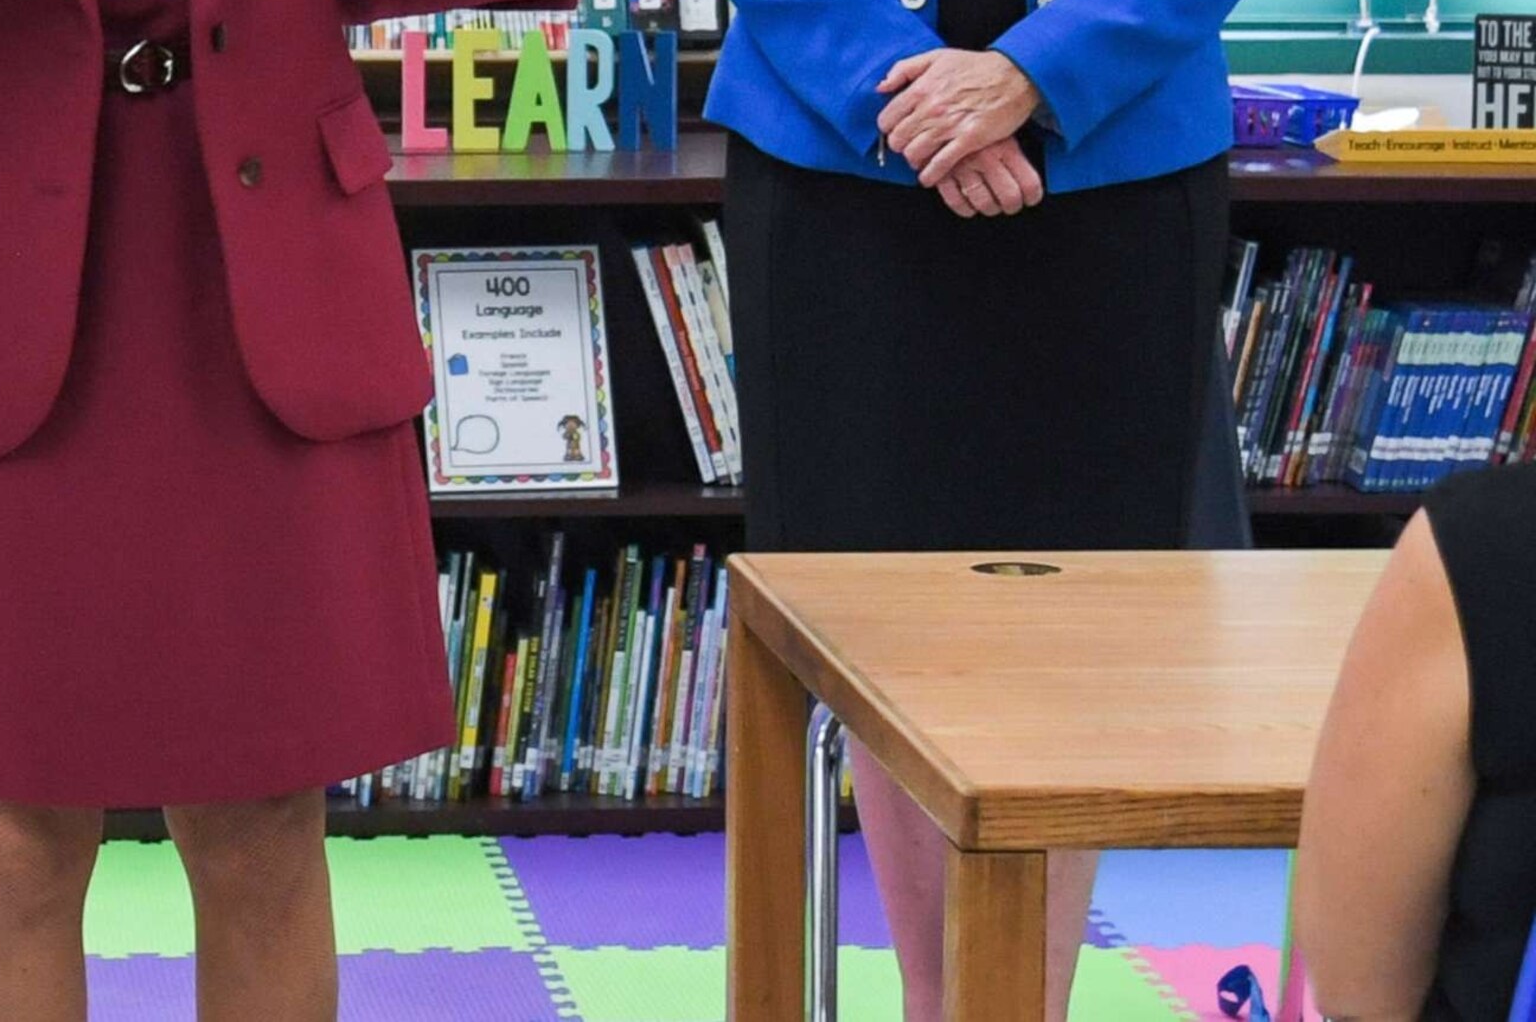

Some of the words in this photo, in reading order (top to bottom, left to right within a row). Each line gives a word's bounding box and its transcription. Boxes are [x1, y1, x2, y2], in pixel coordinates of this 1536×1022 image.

[1478, 19, 1499, 48] TO
[1501, 19, 1534, 49] THE
[401, 28, 678, 151] LEARN
[1475, 81, 1536, 129] HE
[485, 276, 531, 297] 400
[475, 303, 544, 319] Language
[461, 329, 515, 341] Examples
[519, 327, 562, 339] Include
